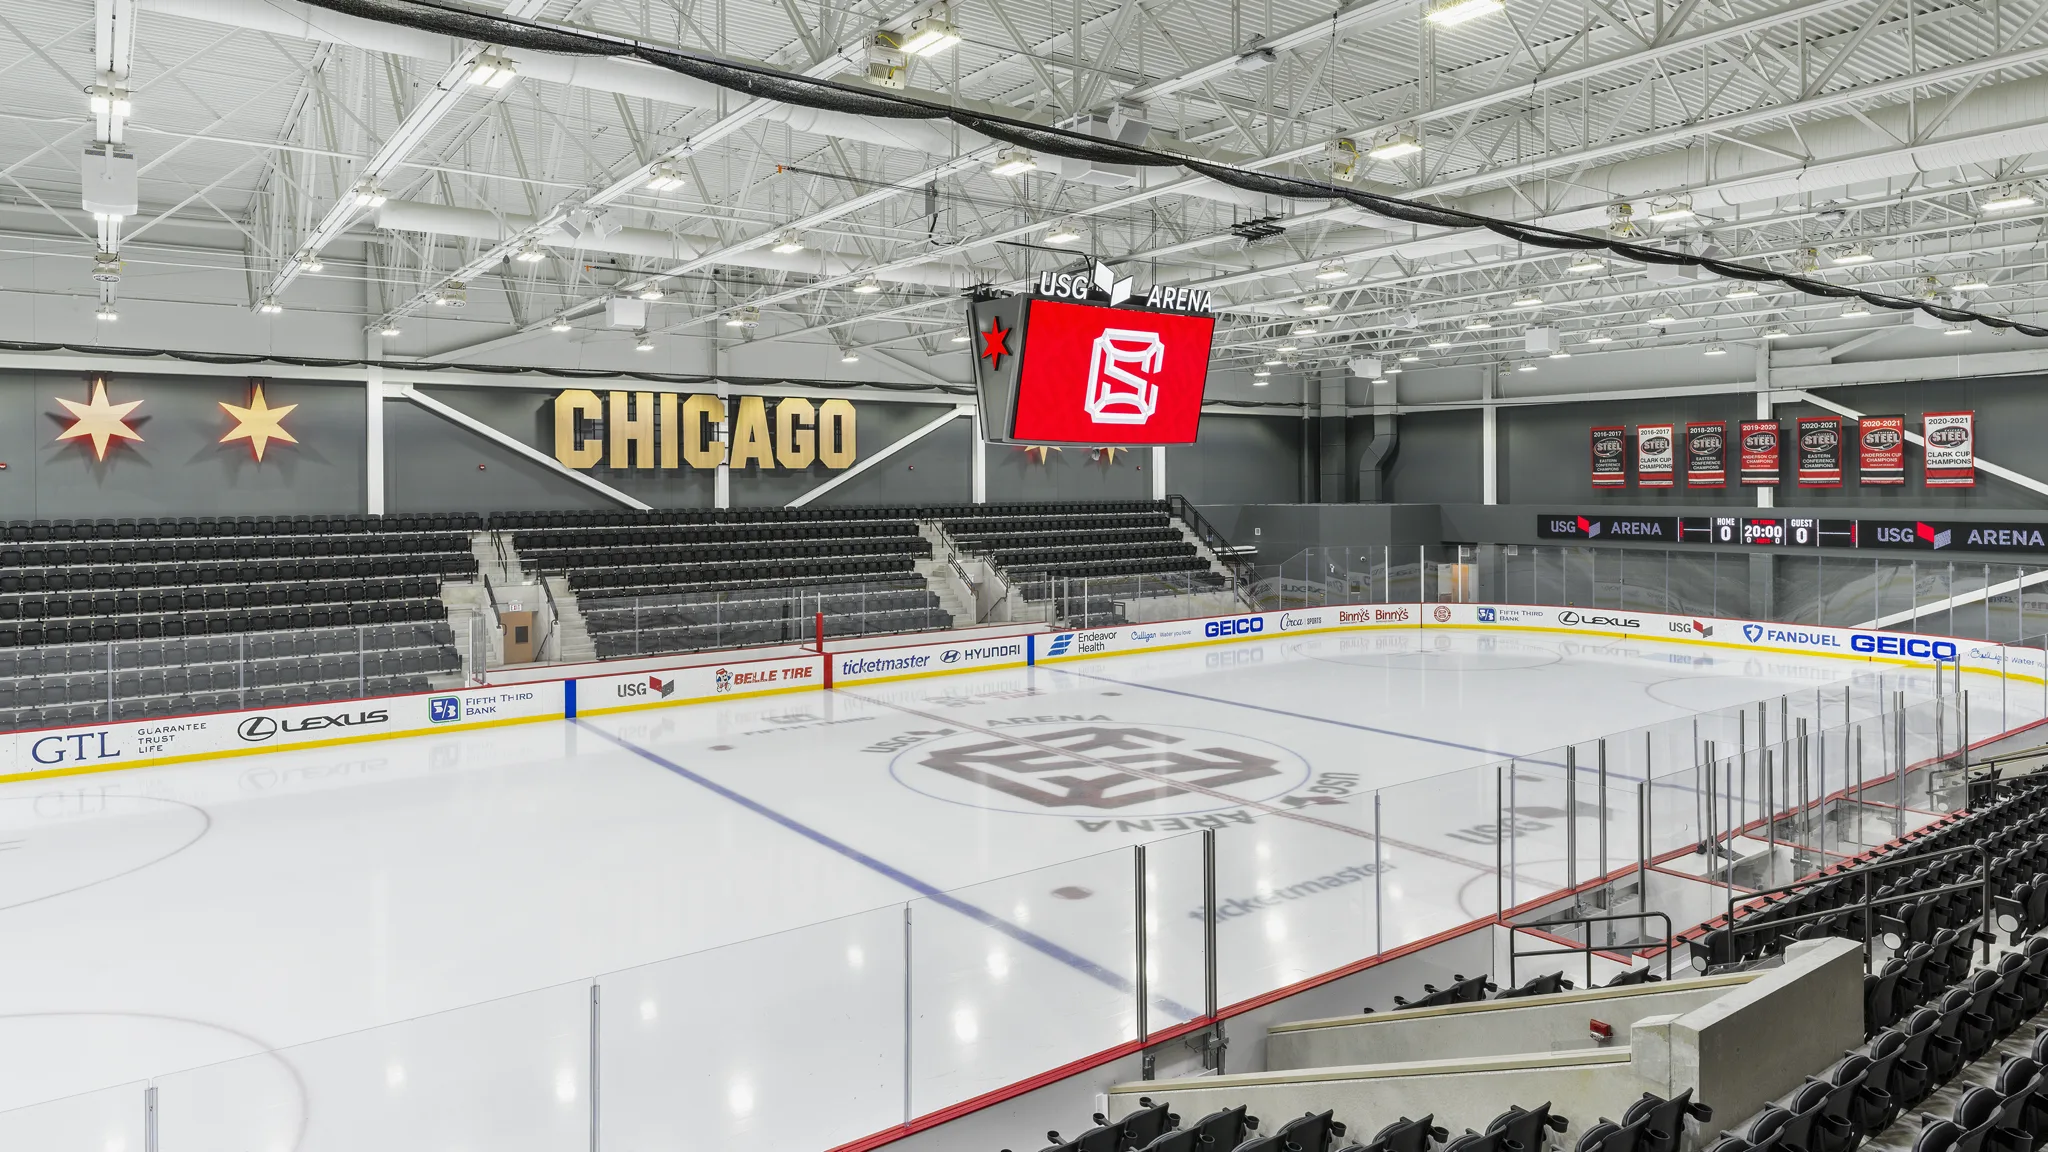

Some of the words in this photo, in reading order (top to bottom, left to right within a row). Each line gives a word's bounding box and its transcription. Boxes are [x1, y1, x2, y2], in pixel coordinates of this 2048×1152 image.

[1040, 271, 1088, 299] USG
[1147, 285, 1213, 312] ARENA
[1862, 420, 1900, 428] 2020-2021
[1929, 417, 1968, 425] 2020-2021
[555, 389, 856, 468] CHICAGO
[1693, 438, 1722, 448] STEEL
[1746, 436, 1776, 446] STEEL
[1804, 434, 1837, 445] STEEL
[1866, 433, 1900, 444] STEEL
[1931, 431, 1968, 442] STEEL
[1597, 441, 1622, 451] STEEL
[1643, 440, 1670, 449] STEEL
[1551, 520, 1576, 533] USG
[1610, 521, 1662, 535] ARENA
[1717, 517, 1735, 526] HOME
[1791, 518, 1813, 527] GUEST
[1720, 525, 1731, 541] 0
[1744, 525, 1783, 538] 20:00
[1796, 527, 1808, 544] 0
[1877, 527, 1914, 543] USG
[1967, 529, 2045, 547] ARENA
[1205, 616, 1264, 638] GEICO
[1280, 612, 1304, 631] Circa
[1306, 617, 1322, 625] SPORTS
[1582, 616, 1640, 628] LEXUS
[1669, 621, 1692, 633] USG
[1078, 631, 1118, 644] Endeavor
[1131, 631, 1157, 642] Culligan
[1768, 630, 1841, 647] FANDUEL
[965, 644, 1021, 661] HYUNDAI
[1078, 642, 1105, 654] Health
[1851, 634, 1957, 662] GEICO
[842, 653, 930, 675] ticketmaster
[734, 669, 778, 685] BELLE
[782, 666, 813, 680] TIRE
[617, 682, 647, 698] USG
[466, 706, 496, 716] BANK
[281, 709, 389, 732] LEXUS
[986, 714, 1113, 727] ARENA
[138, 722, 207, 735] GUARANTEE
[138, 734, 175, 744] TRUST
[860, 733, 922, 753] USG
[31, 731, 121, 764] GTL
[138, 745, 163, 754] LIFE
[1319, 771, 1360, 796] USG
[1076, 809, 1256, 834] ARENA
